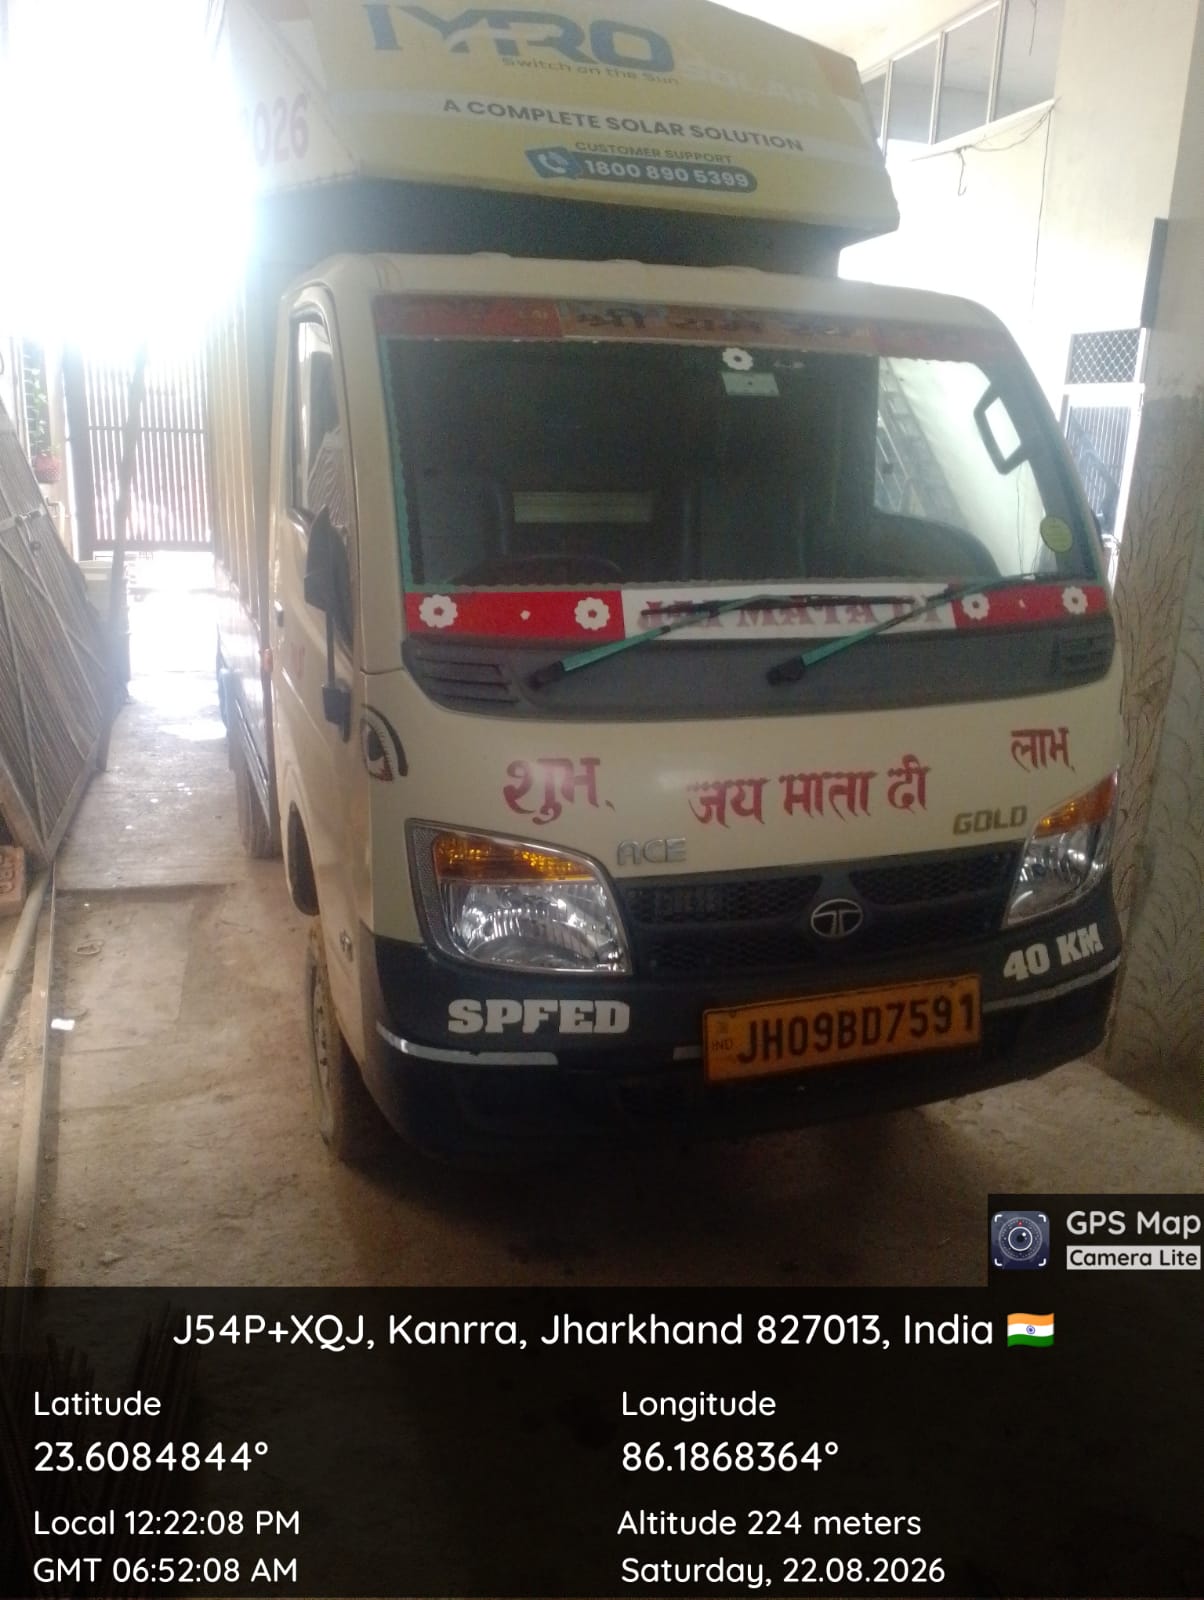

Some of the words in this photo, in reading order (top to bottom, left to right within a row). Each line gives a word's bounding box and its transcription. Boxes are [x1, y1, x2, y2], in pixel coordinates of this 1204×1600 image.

[502, 56, 572, 73] Switch
[577, 66, 601, 76] on
[606, 66, 638, 80] the
[646, 72, 681, 86] Sun
[241, 92, 309, 167] 026
[442, 98, 462, 114] A
[466, 101, 601, 130] COMPLETE
[605, 116, 685, 138] SOLAR
[689, 123, 805, 152] SOLUTION
[574, 141, 662, 158] CUSTOMER
[664, 146, 733, 165] SUPPORT
[584, 158, 642, 179] 1800
[645, 164, 690, 182] 890
[693, 169, 750, 188] 5399
[1010, 726, 1076, 773] लाभ
[686, 777, 771, 829] जय
[777, 769, 878, 825] माता
[886, 753, 932, 815] दी
[952, 804, 1029, 836] GOLD
[616, 836, 687, 867] ACE
[1003, 942, 1051, 982] 40
[1055, 921, 1105, 966] KM
[447, 998, 631, 1035] SPFED
[735, 992, 976, 1065] JH09BD7591
